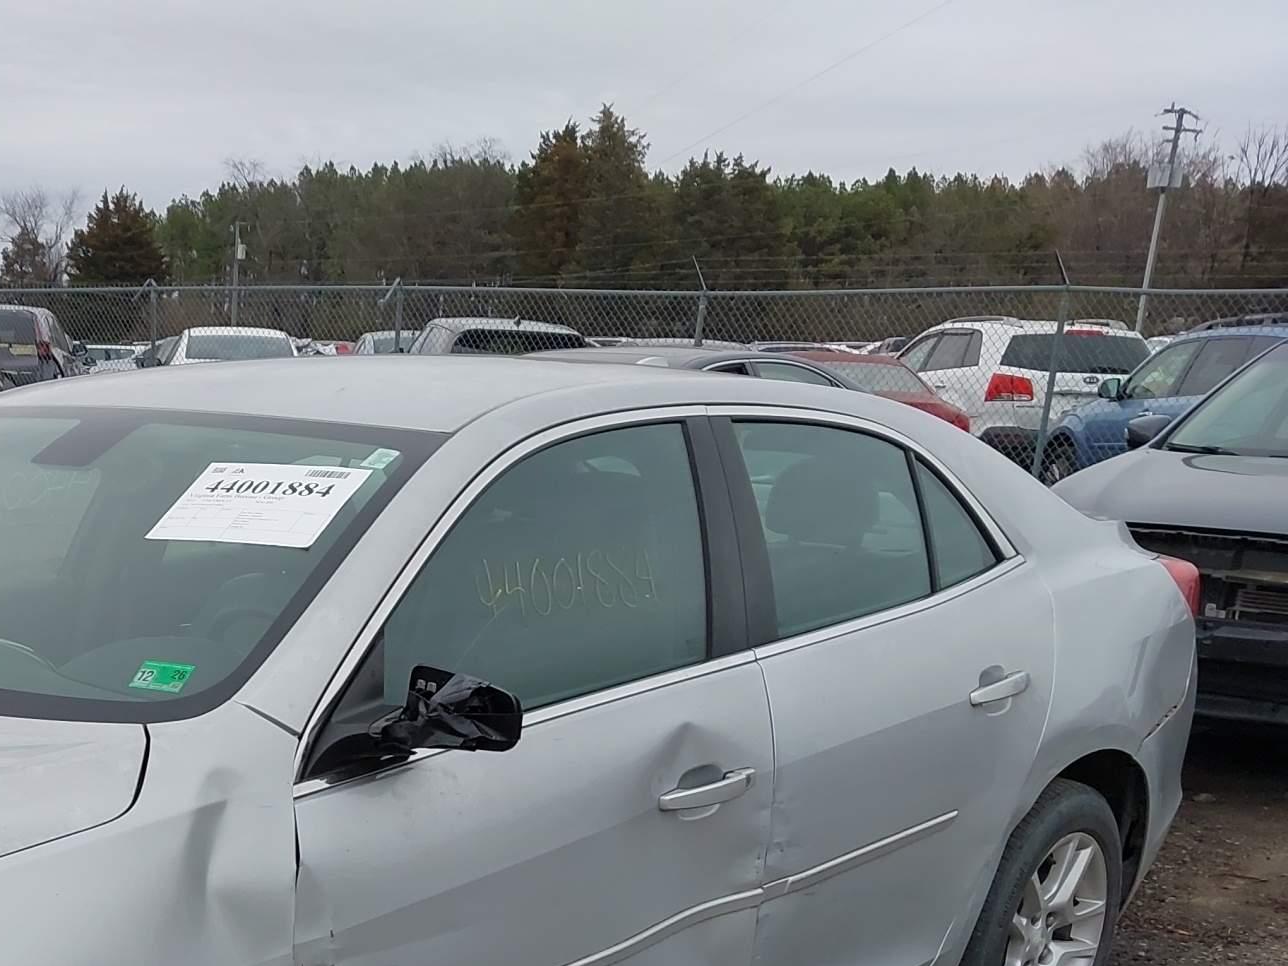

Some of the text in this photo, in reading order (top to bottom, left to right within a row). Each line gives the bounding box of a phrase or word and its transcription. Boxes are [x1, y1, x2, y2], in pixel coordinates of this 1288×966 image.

[205, 479, 336, 498] 44001884
[476, 549, 658, 617] 44001884
[137, 669, 188, 682] 12 26
